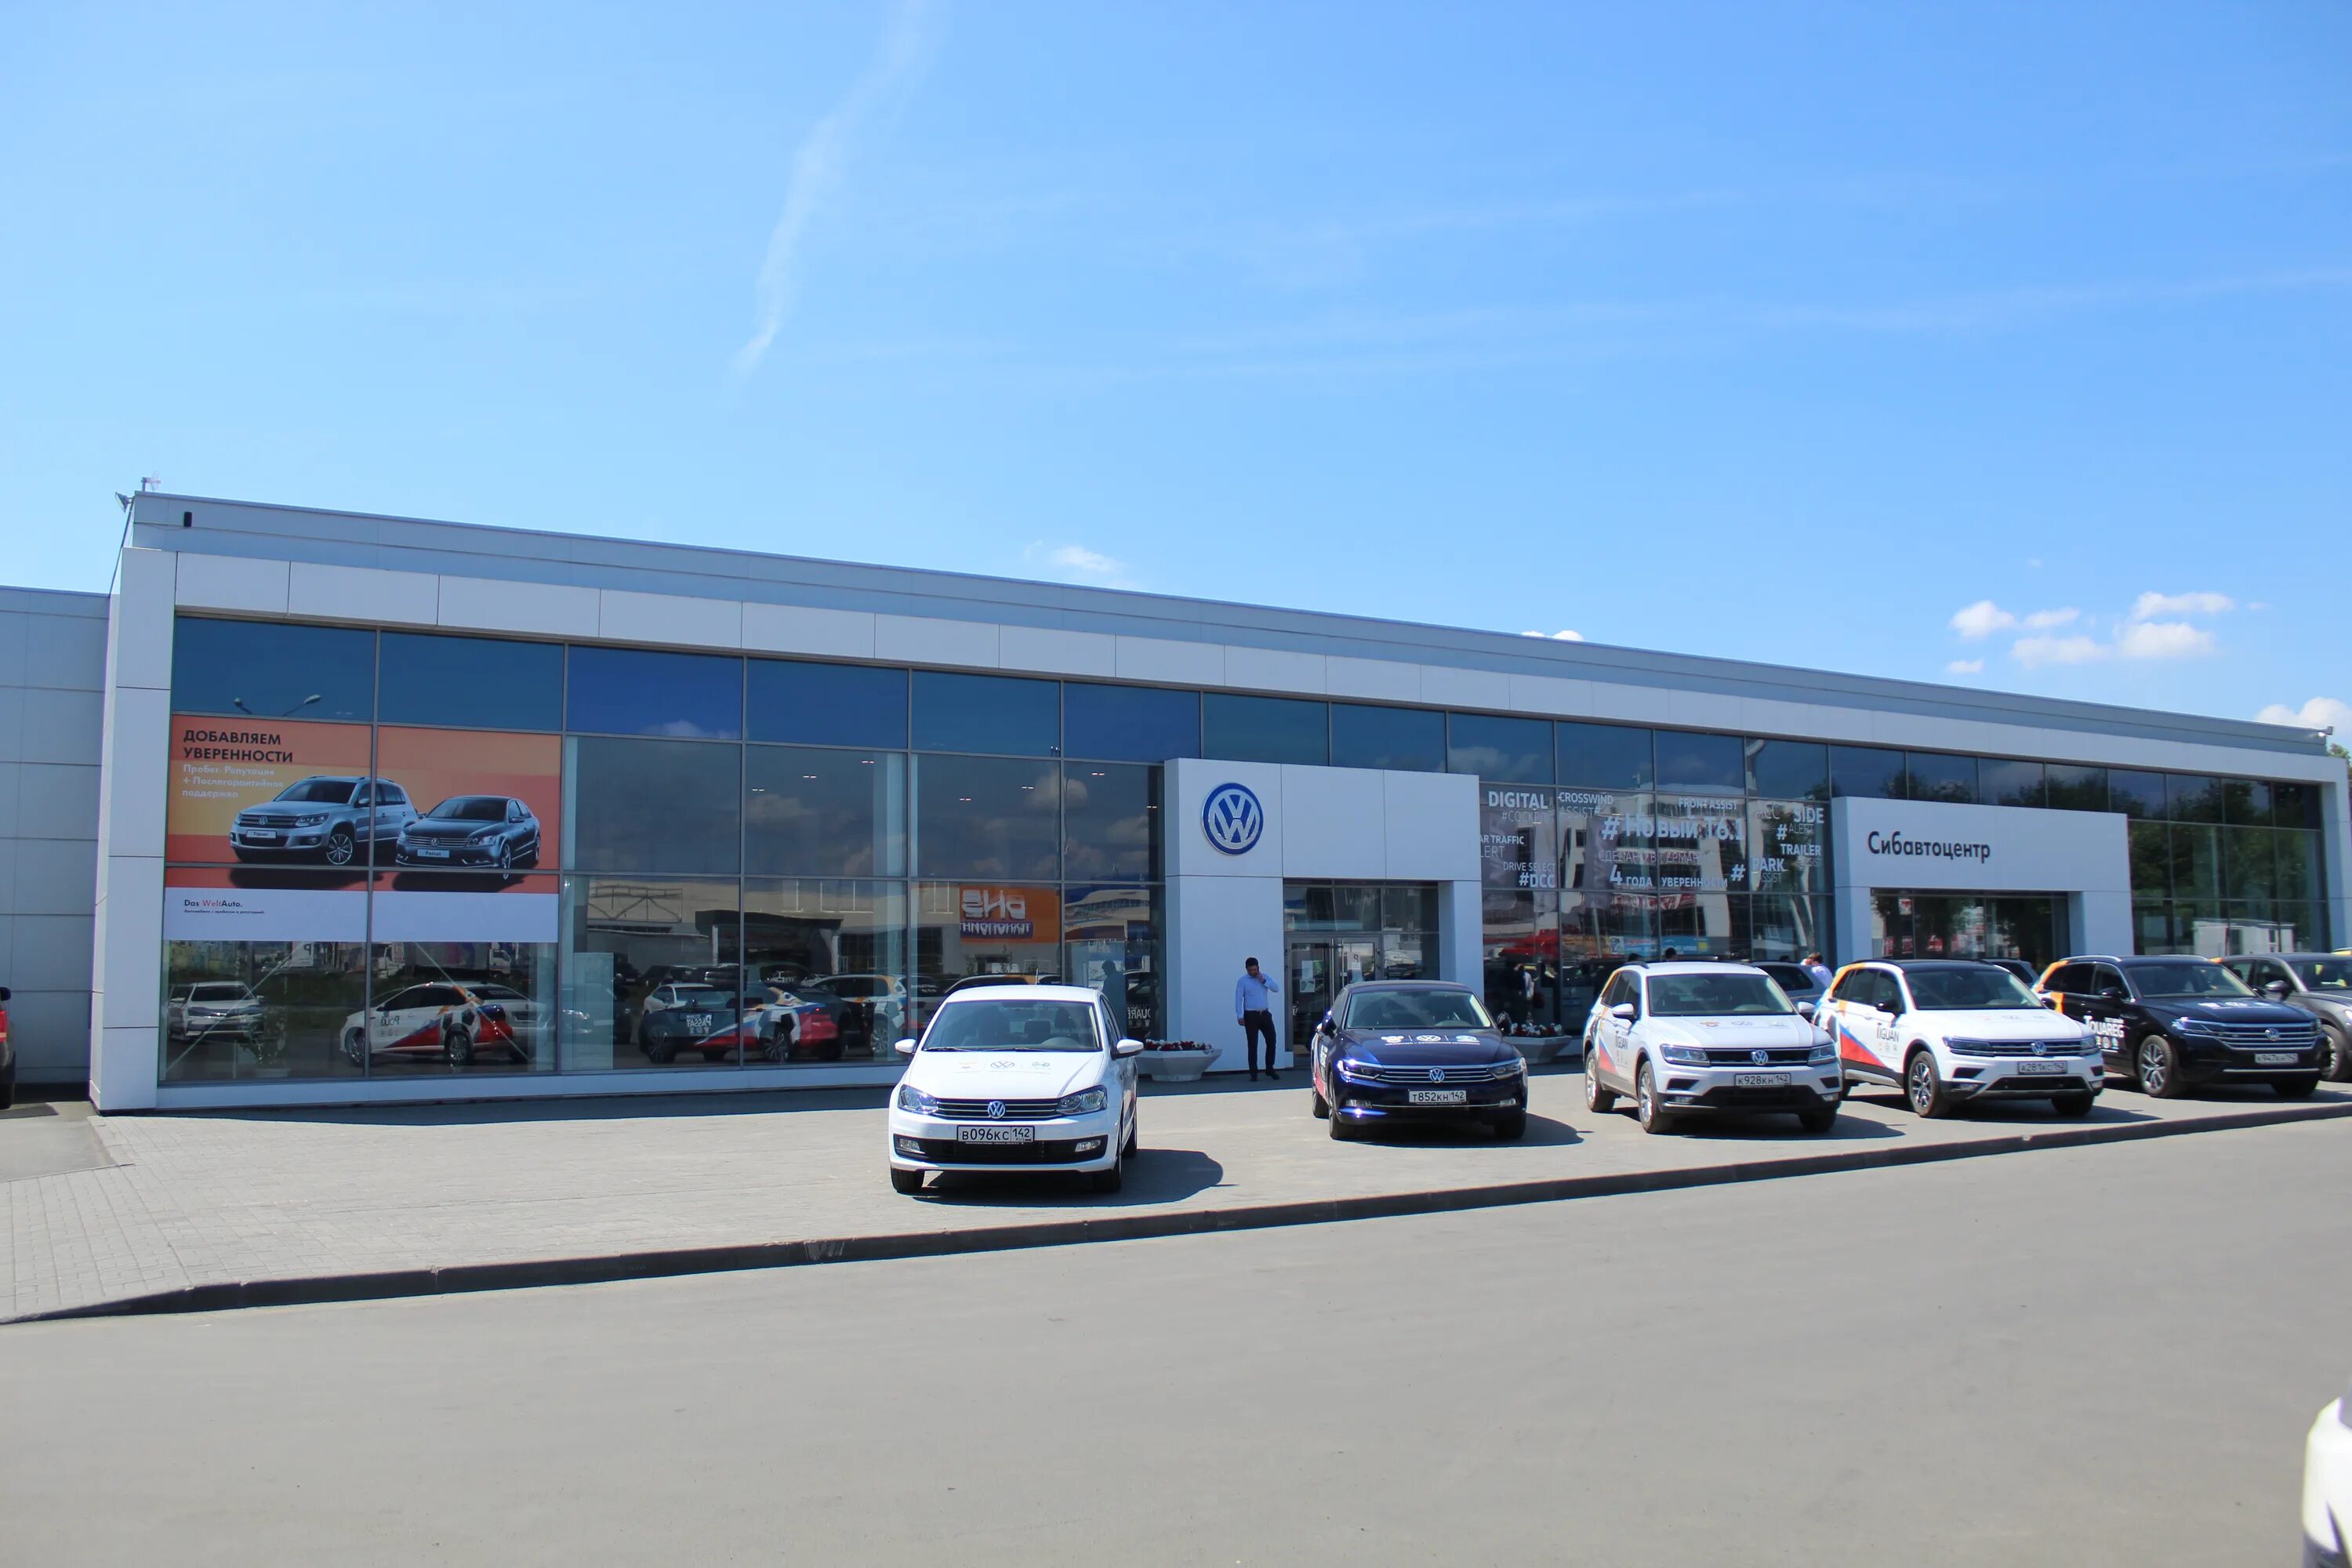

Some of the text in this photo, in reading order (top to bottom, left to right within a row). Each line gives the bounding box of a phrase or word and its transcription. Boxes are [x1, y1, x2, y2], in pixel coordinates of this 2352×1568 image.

[183, 730, 281, 745] ДОБАВЛЯЕМ
[183, 747, 292, 762] УВЕРЕННОСТИ
[1488, 791, 1548, 809] DIGITAL
[1559, 793, 1613, 804] CROSSWIND
[1679, 797, 1737, 810] FRONT ASSIST
[1207, 789, 1261, 851] VW
[1793, 807, 1824, 823] SIDE
[1491, 835, 1525, 845] TRAFFIC
[1867, 831, 1991, 863] Сибавтоцентр
[1599, 851, 1646, 862] СДЕЛАН
[1661, 852, 1700, 863] ГЕРМАН
[1780, 844, 1822, 856] TRAILER
[1503, 862, 1556, 872] DRIVE SELECT
[1519, 872, 1555, 887] #DCC
[1610, 864, 1728, 887] 4 ГОДА УВЕРЕННОСТИ
[1012, 1128, 1030, 1138] 142
